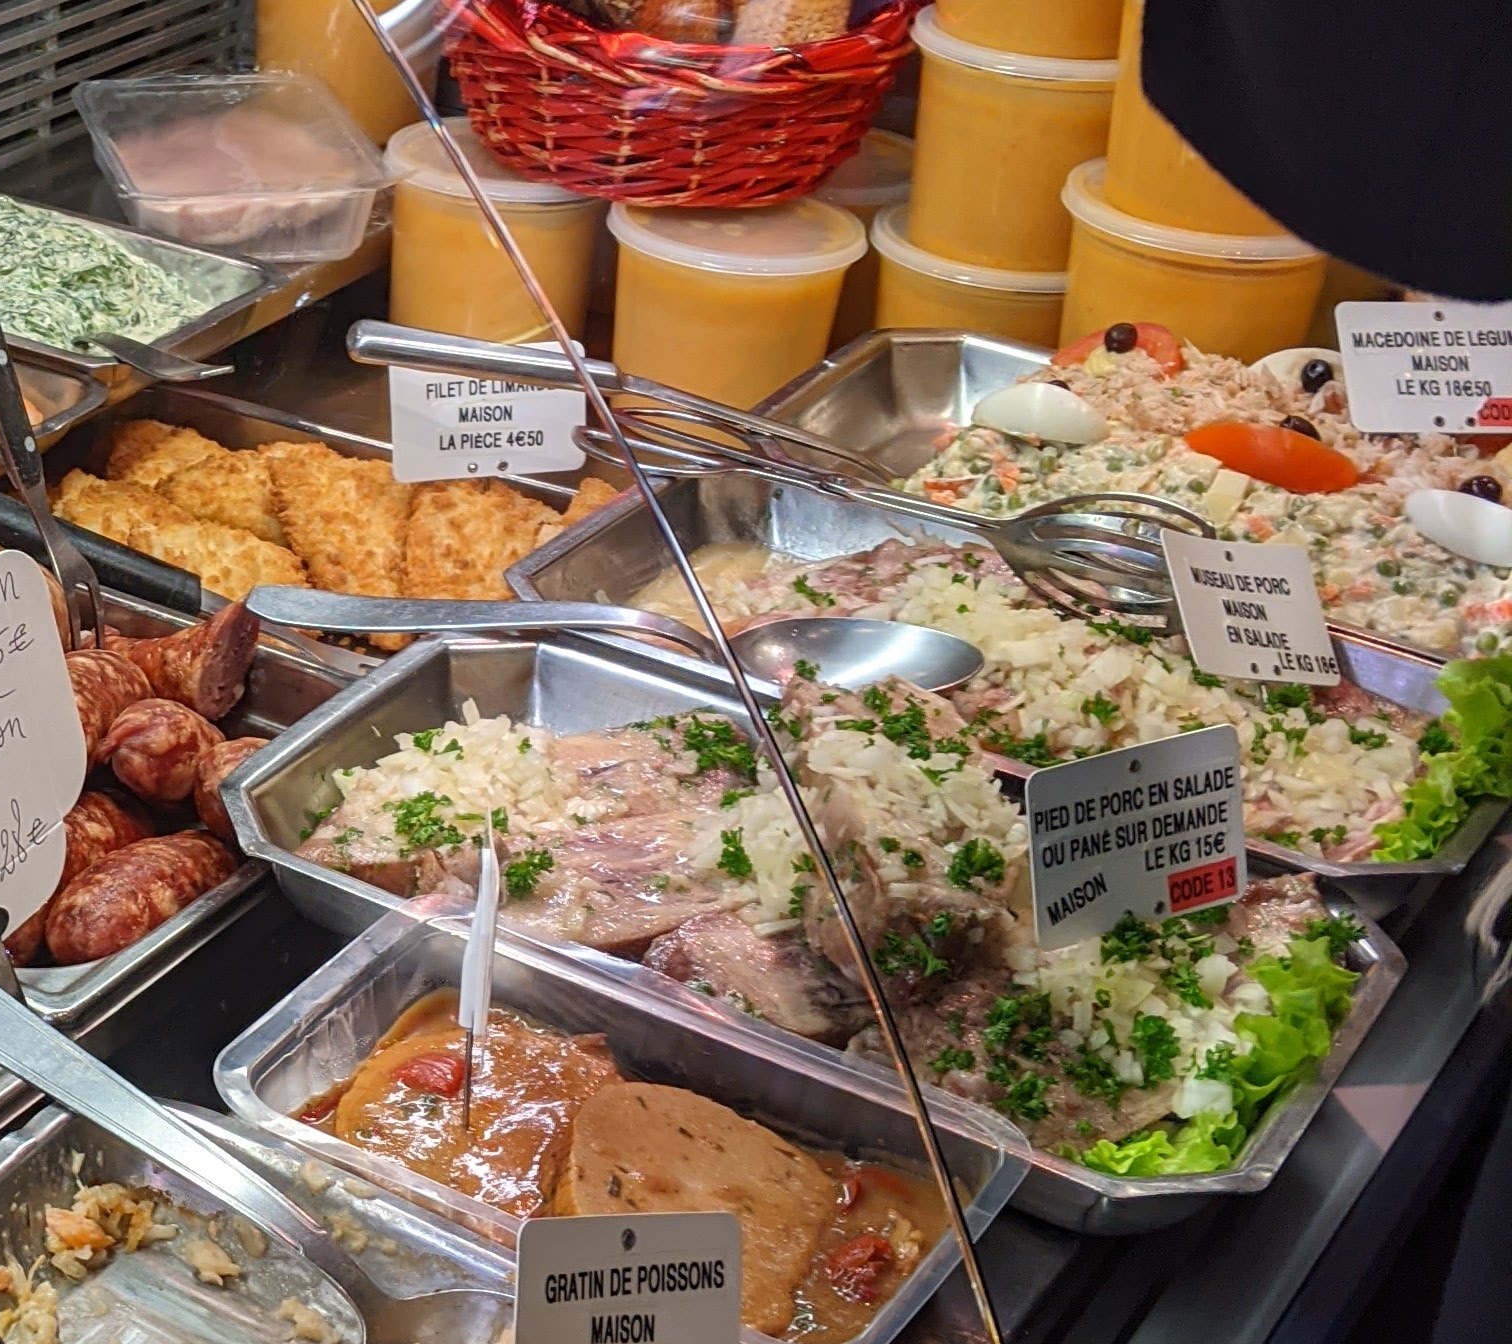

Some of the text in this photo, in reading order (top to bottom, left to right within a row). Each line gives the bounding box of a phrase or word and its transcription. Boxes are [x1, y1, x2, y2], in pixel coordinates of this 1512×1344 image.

[1351, 330, 1441, 348] MACÉDOINE
[1444, 330, 1466, 347] DE
[1411, 355, 1470, 372] MAISON
[426, 381, 464, 400] FILET
[469, 380, 487, 396] DE
[1396, 378, 1493, 397] LE KG 18€50
[458, 405, 513, 423] MAISON
[439, 430, 544, 451] LA PIÈCE 4€50
[1190, 566, 1291, 596] MUSEAU DE PORC
[1222, 599, 1269, 622] MAISON
[1226, 625, 1291, 650] EN SALADE
[1277, 652, 1294, 671] LE
[1297, 654, 1314, 673] KG
[1034, 766, 1235, 835] PIED DE PORC EN SALADE
[1042, 800, 1229, 869] OU PANÉ SUR DEMANDE
[1145, 832, 1226, 872] LE KG 15€
[1169, 866, 1236, 904] CODE 13
[1046, 873, 1108, 926] MAISON
[545, 1260, 725, 1304] GRATIN DE POISSONS
[591, 1314, 656, 1344] MAISON
